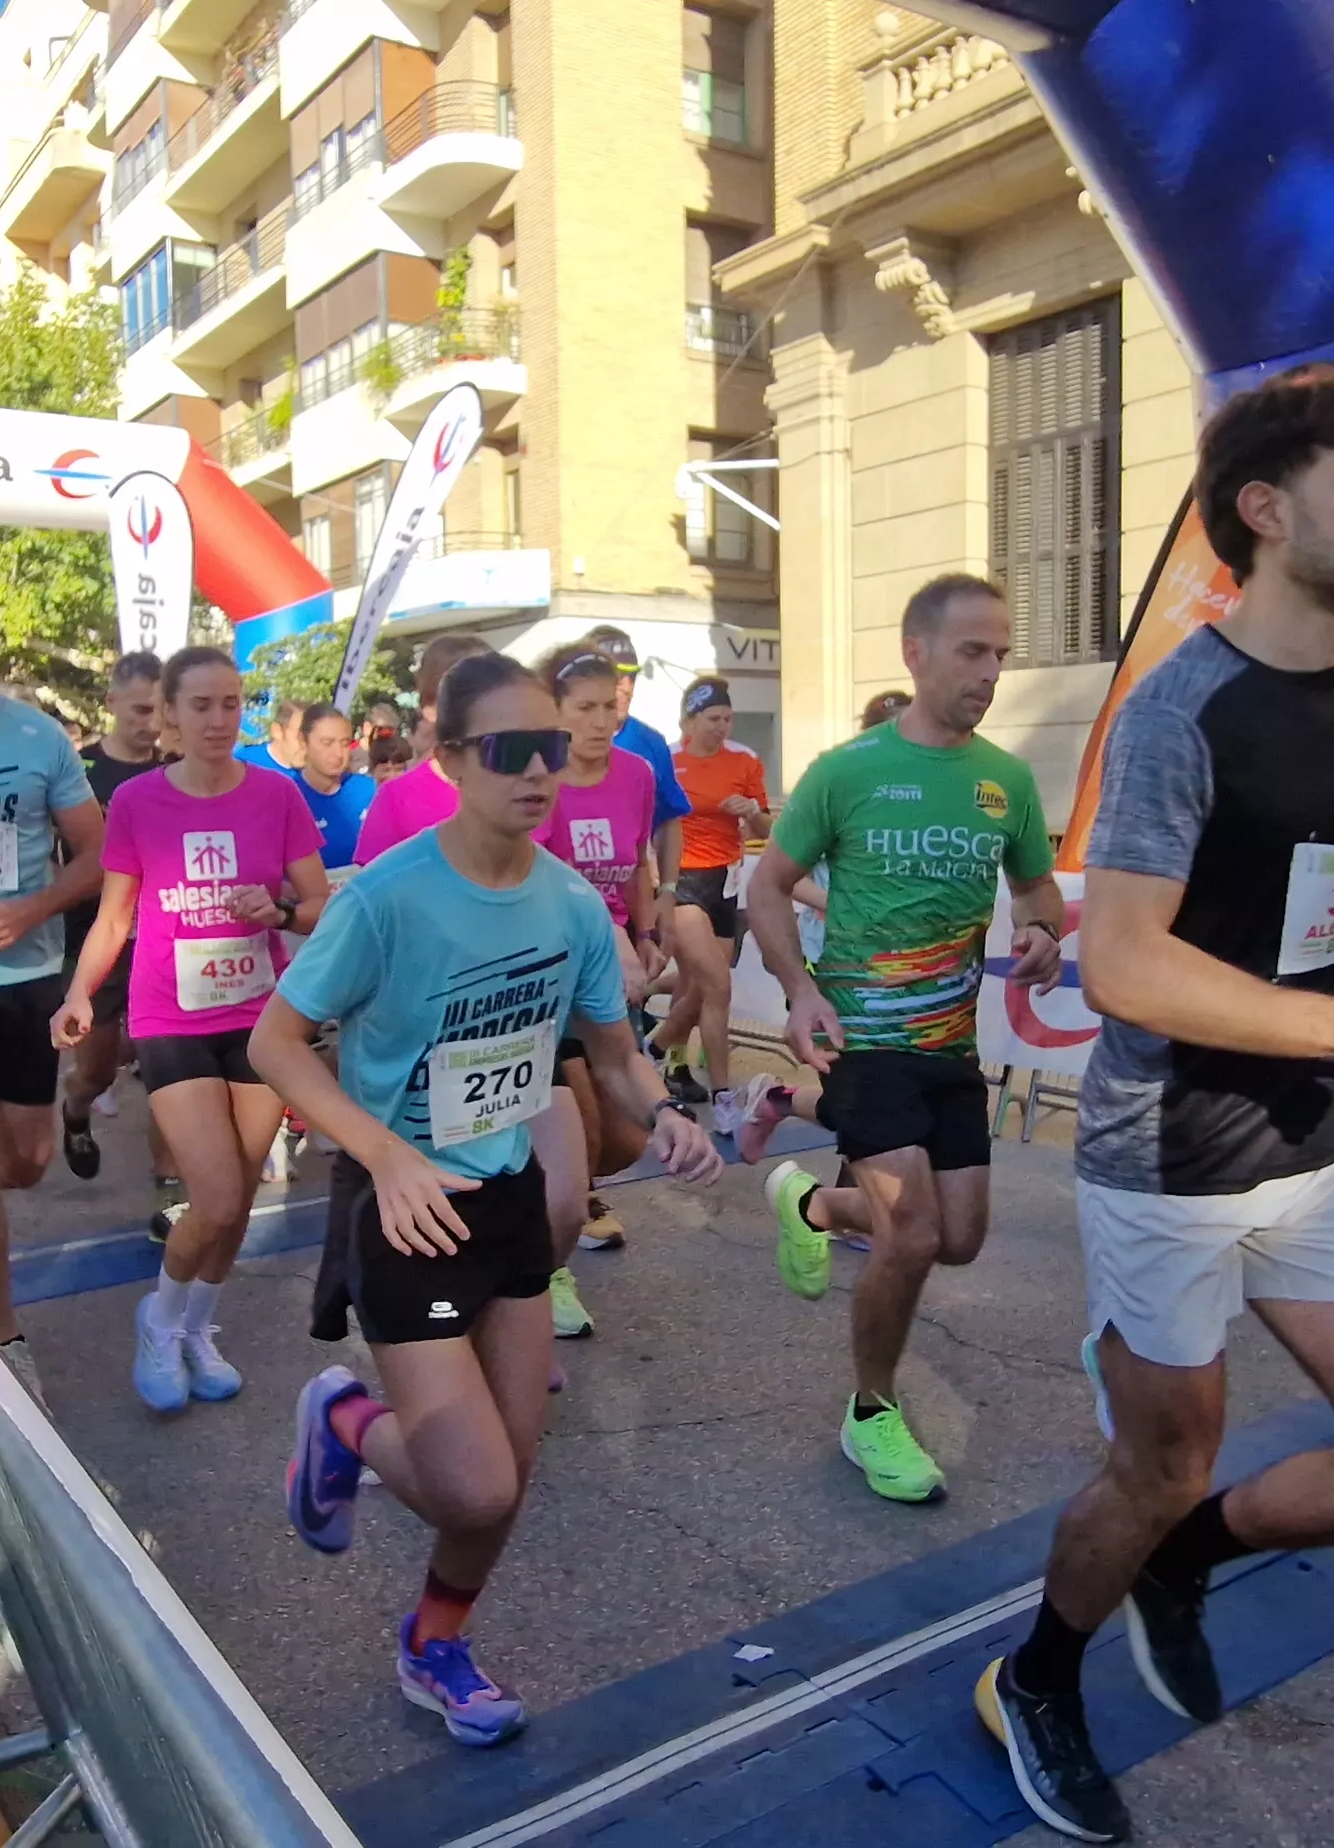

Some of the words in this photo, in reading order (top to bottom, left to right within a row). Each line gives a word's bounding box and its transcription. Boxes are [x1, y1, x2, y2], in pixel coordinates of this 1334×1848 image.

[158, 879, 267, 913] salesia
[201, 956, 255, 979] 430
[442, 999, 468, 1030] III
[472, 977, 545, 1020] CARRERA
[463, 1060, 533, 1103] 270
[474, 1094, 521, 1118] JULIA
[471, 1117, 494, 1134] 8K
